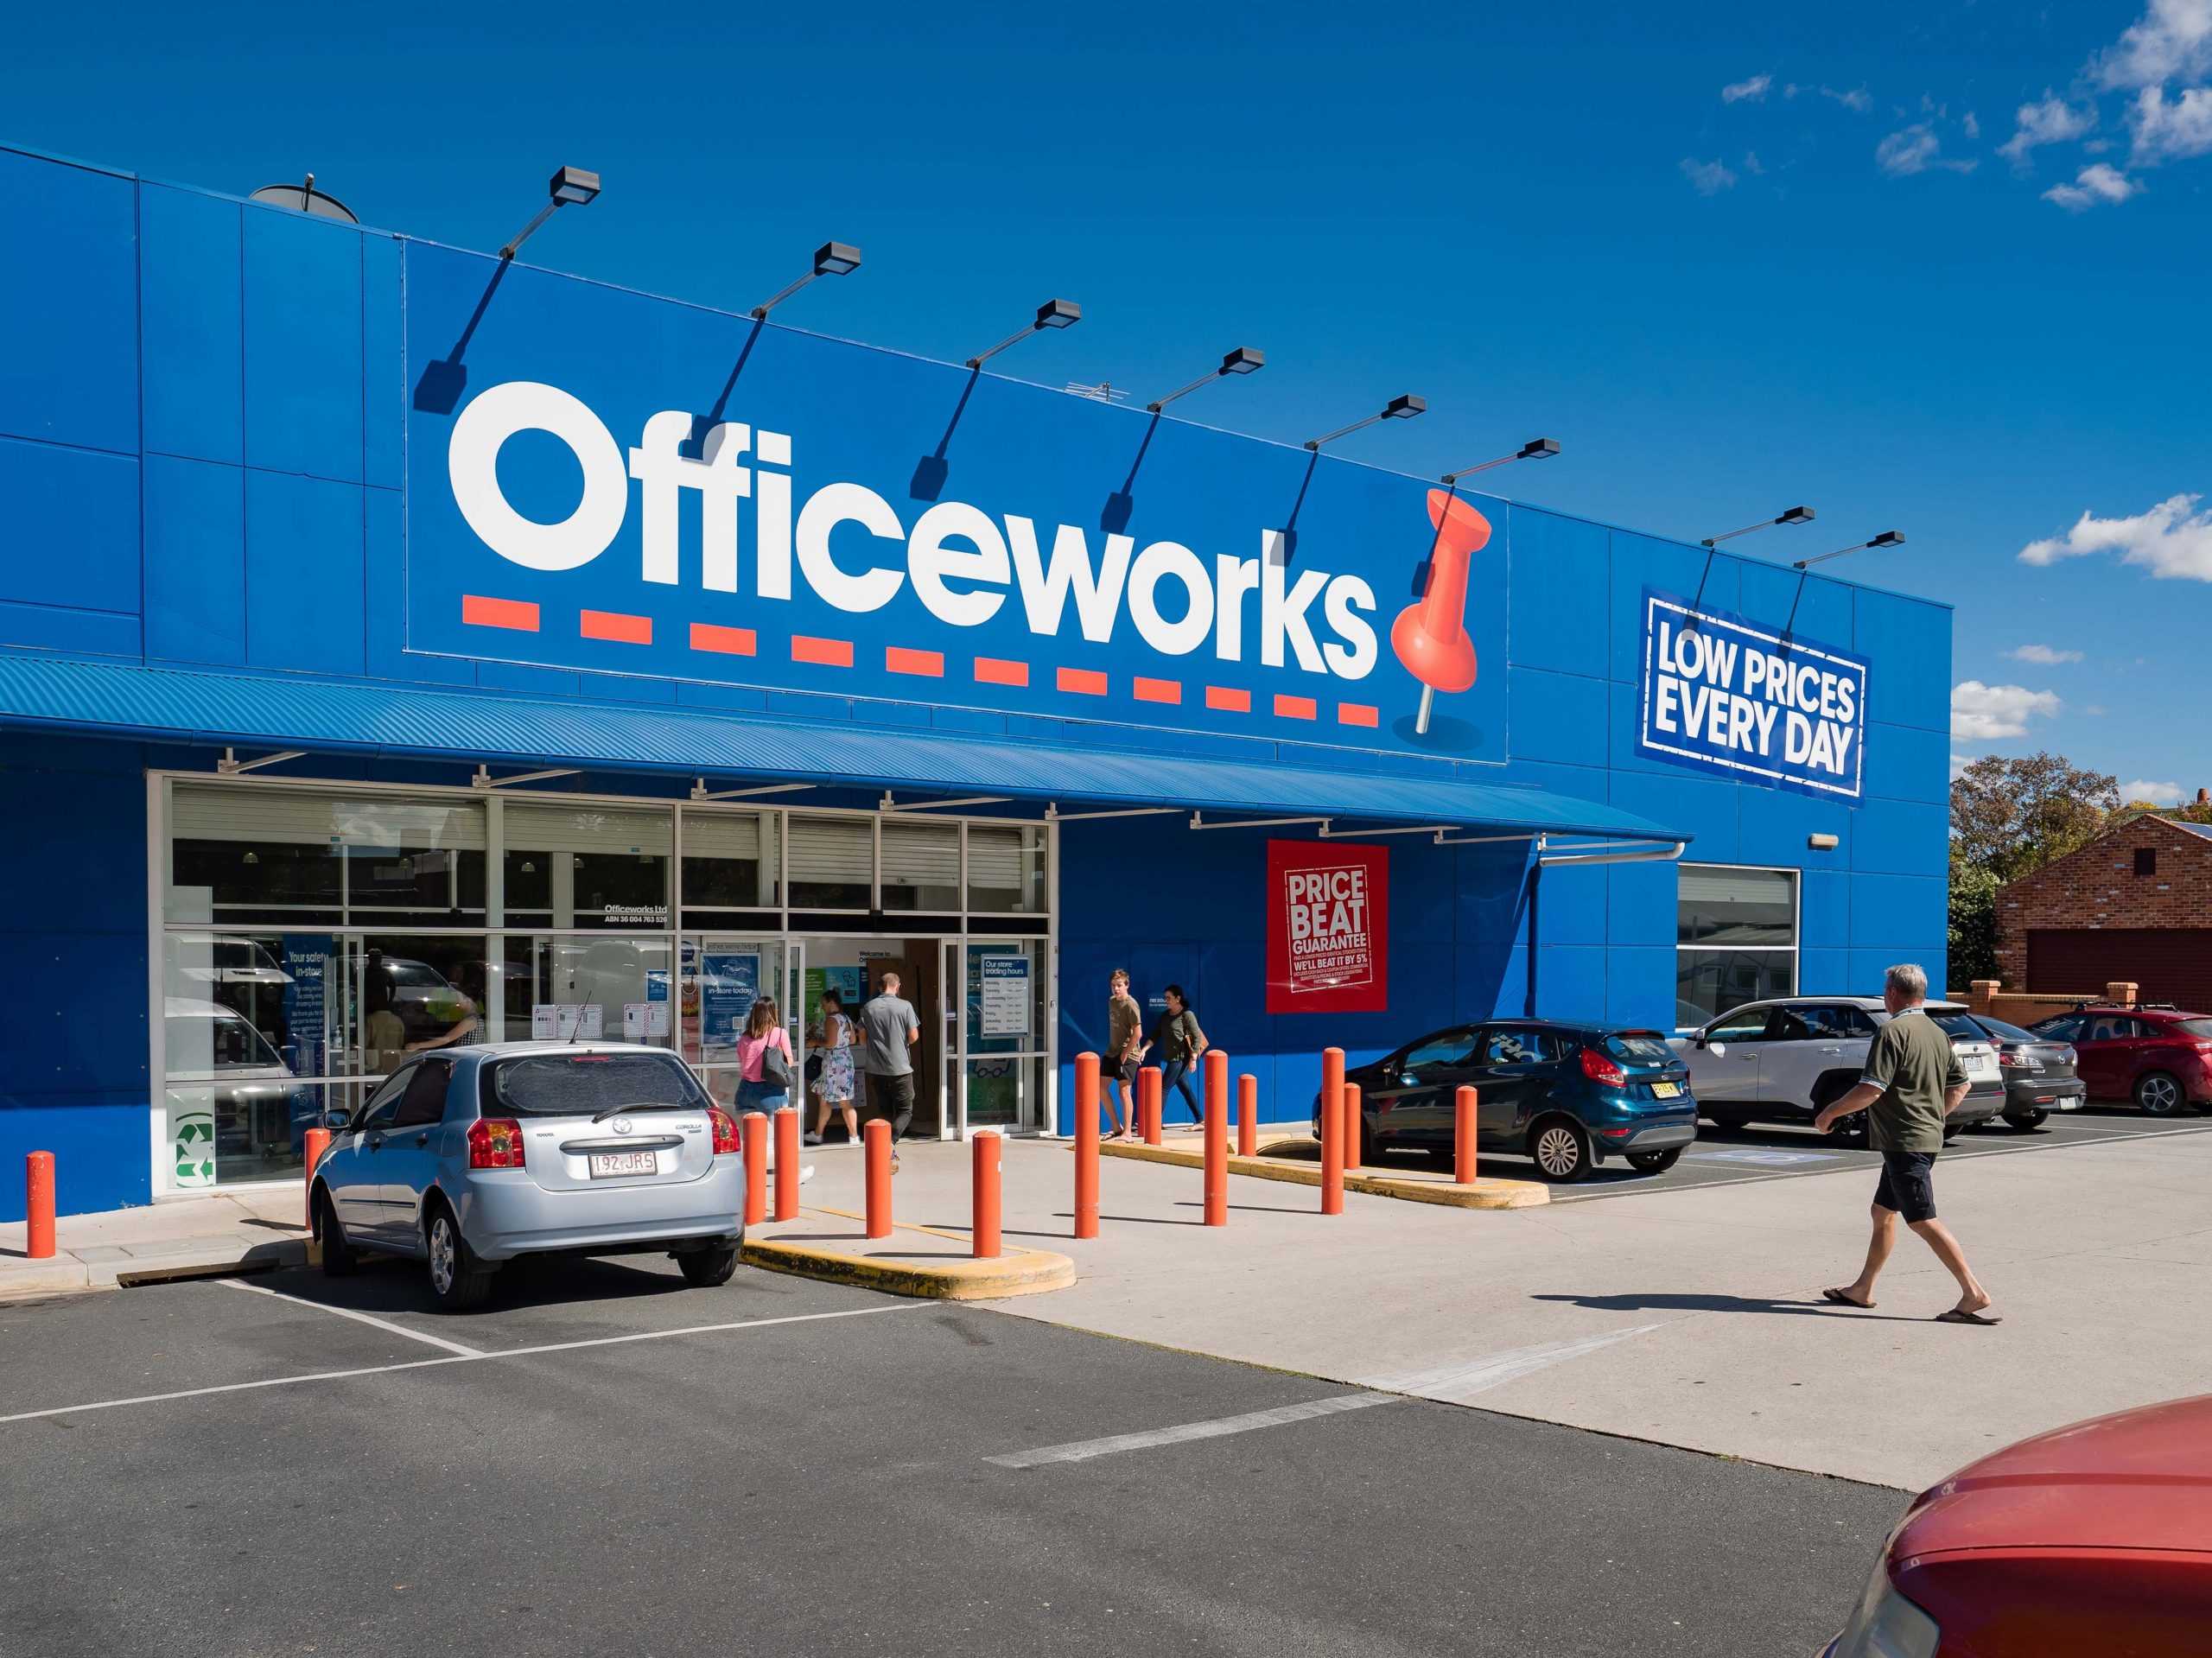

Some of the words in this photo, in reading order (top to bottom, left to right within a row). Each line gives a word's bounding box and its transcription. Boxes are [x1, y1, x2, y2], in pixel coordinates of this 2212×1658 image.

[448, 381, 1378, 679] Officeworks
[1658, 621, 1738, 689] LOW
[1744, 648, 1856, 723] PRICES
[1656, 674, 1779, 756] EVERY
[1784, 711, 1854, 776] DAY
[1289, 871, 1363, 904] PRICE
[605, 905, 654, 913] Officeworks
[1291, 899, 1365, 940] BEAT
[1293, 934, 1367, 955] GUARANTEE
[289, 951, 305, 962] Your
[1294, 960, 1317, 971] WE'LL
[1318, 956, 1336, 968] BEAT
[1337, 956, 1344, 966] IT
[1344, 954, 1355, 965] BY
[1357, 954, 1368, 963] 5%
[985, 968, 1007, 976] trading
[733, 987, 752, 996] today
[626, 1153, 653, 1169] JRS
